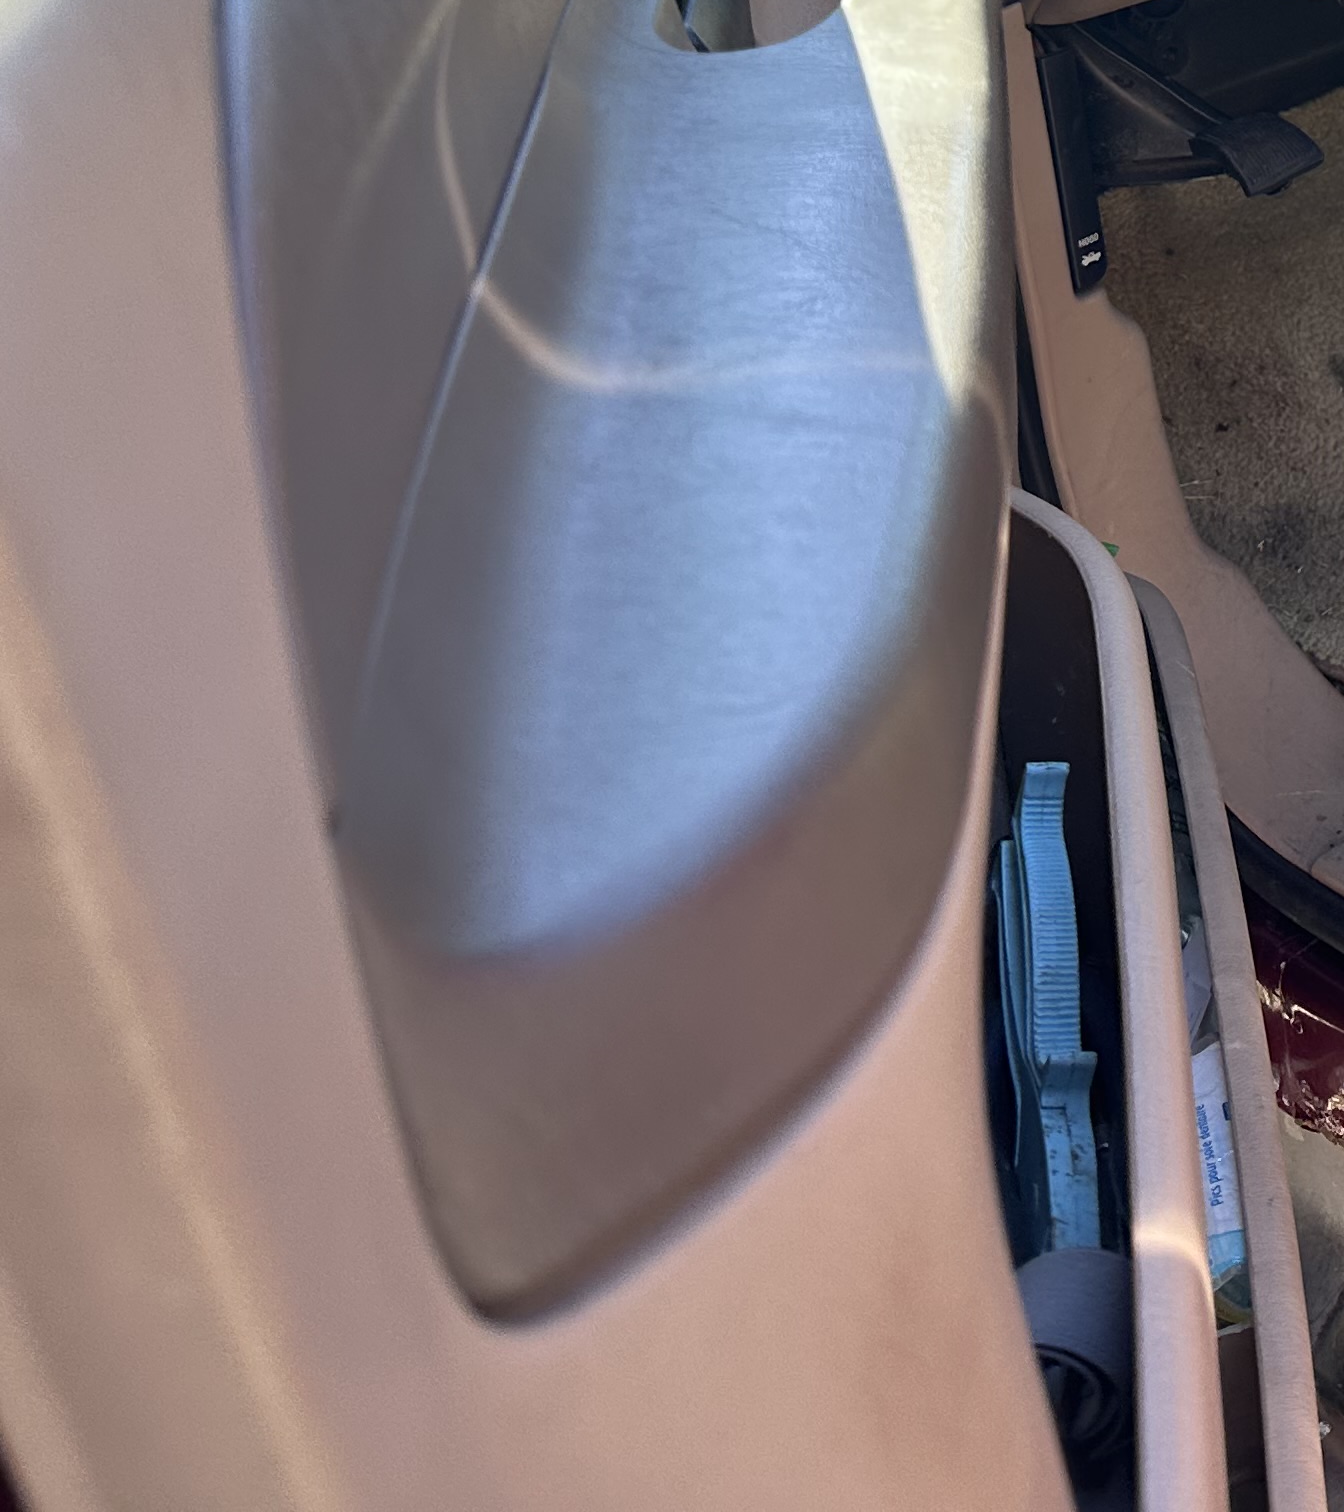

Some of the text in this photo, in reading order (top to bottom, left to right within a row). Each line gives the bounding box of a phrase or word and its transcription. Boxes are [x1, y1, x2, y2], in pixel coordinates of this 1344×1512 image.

[1078, 232, 1099, 248] HOOD
[1201, 1140, 1215, 1161] soie
[1206, 1162, 1224, 1184] pour
[1209, 1185, 1224, 1207] Pics
